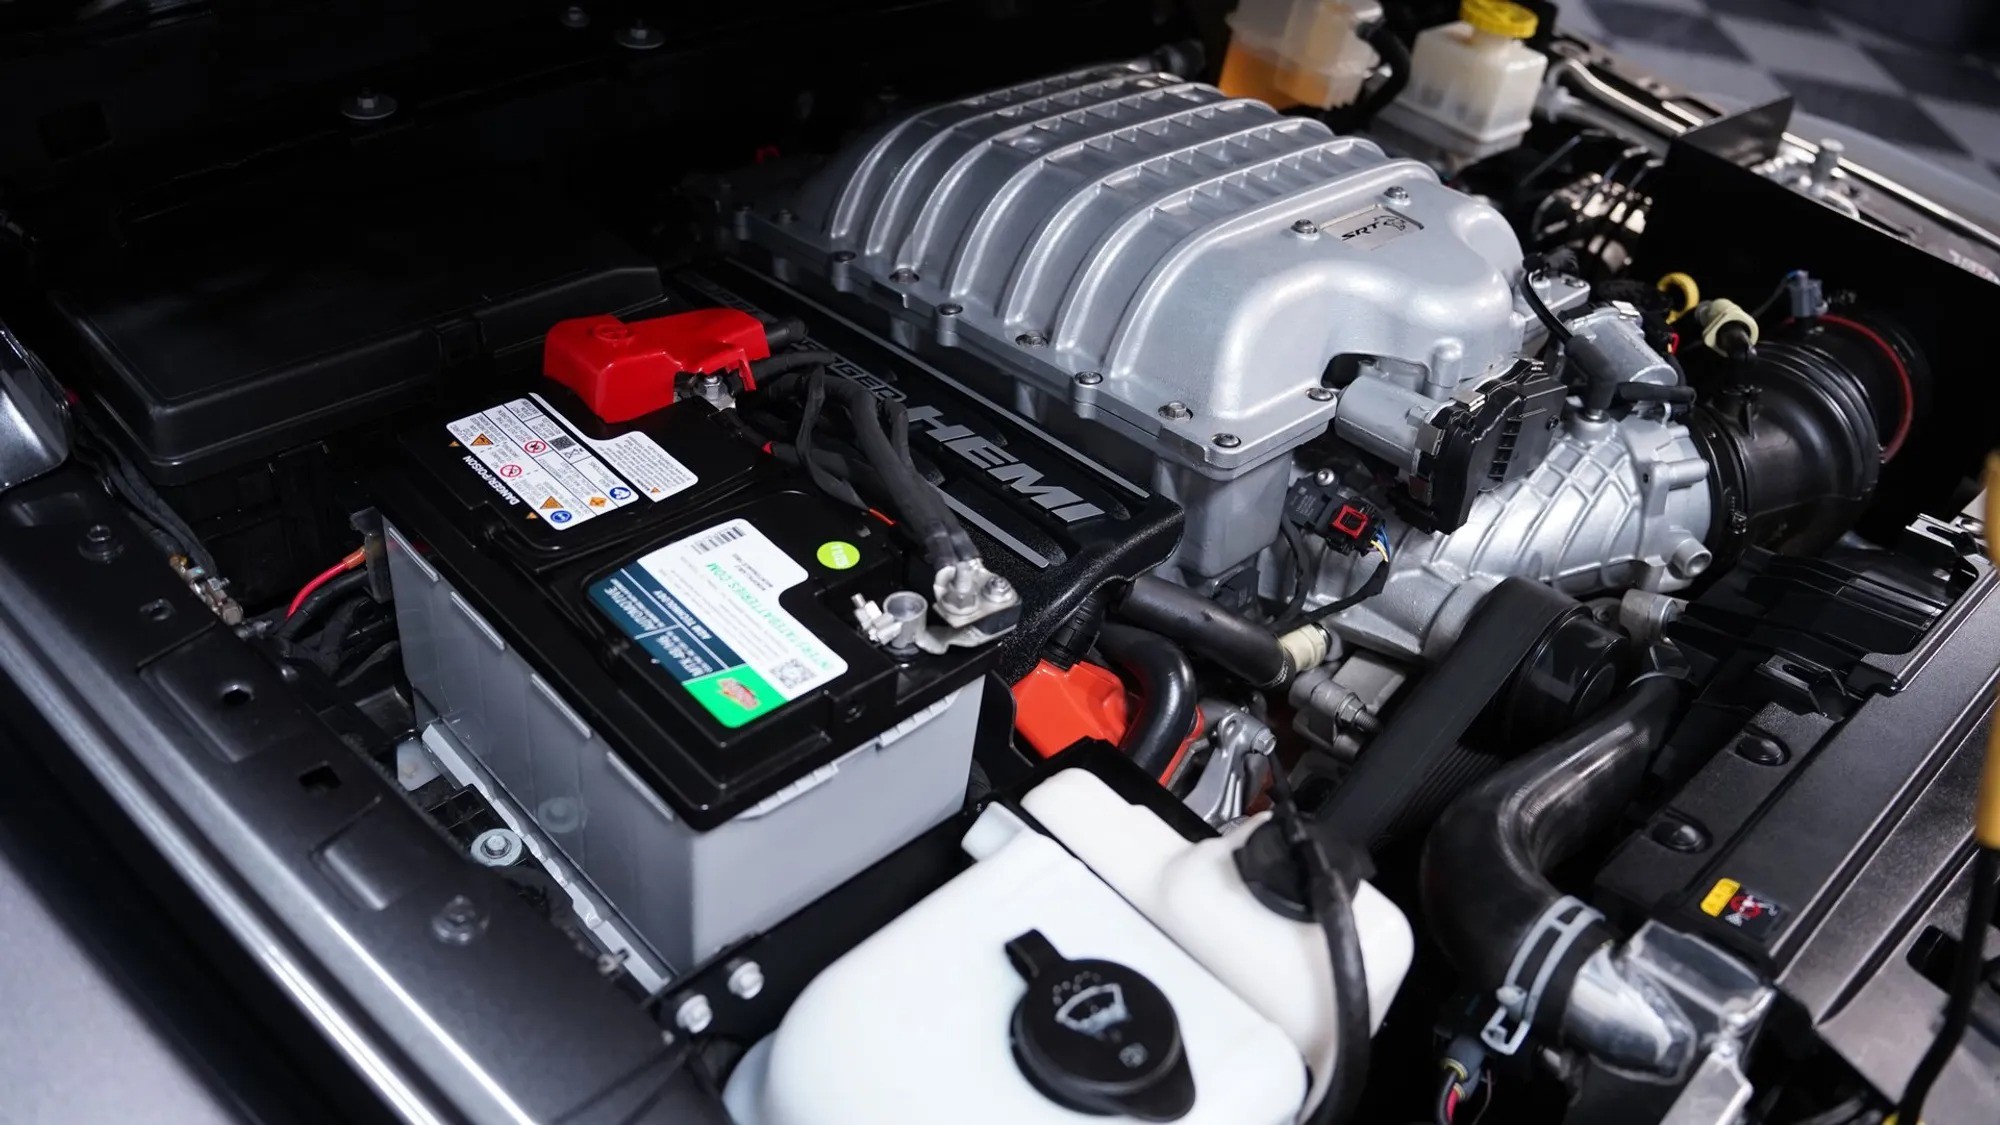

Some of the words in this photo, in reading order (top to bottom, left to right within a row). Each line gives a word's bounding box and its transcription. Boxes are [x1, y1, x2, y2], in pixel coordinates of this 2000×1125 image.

[1341, 221, 1380, 241] SRT
[461, 454, 521, 505] DANGER/POISON
[908, 404, 1106, 525] HEMI
[602, 584, 658, 633] AUTOMOTIVE
